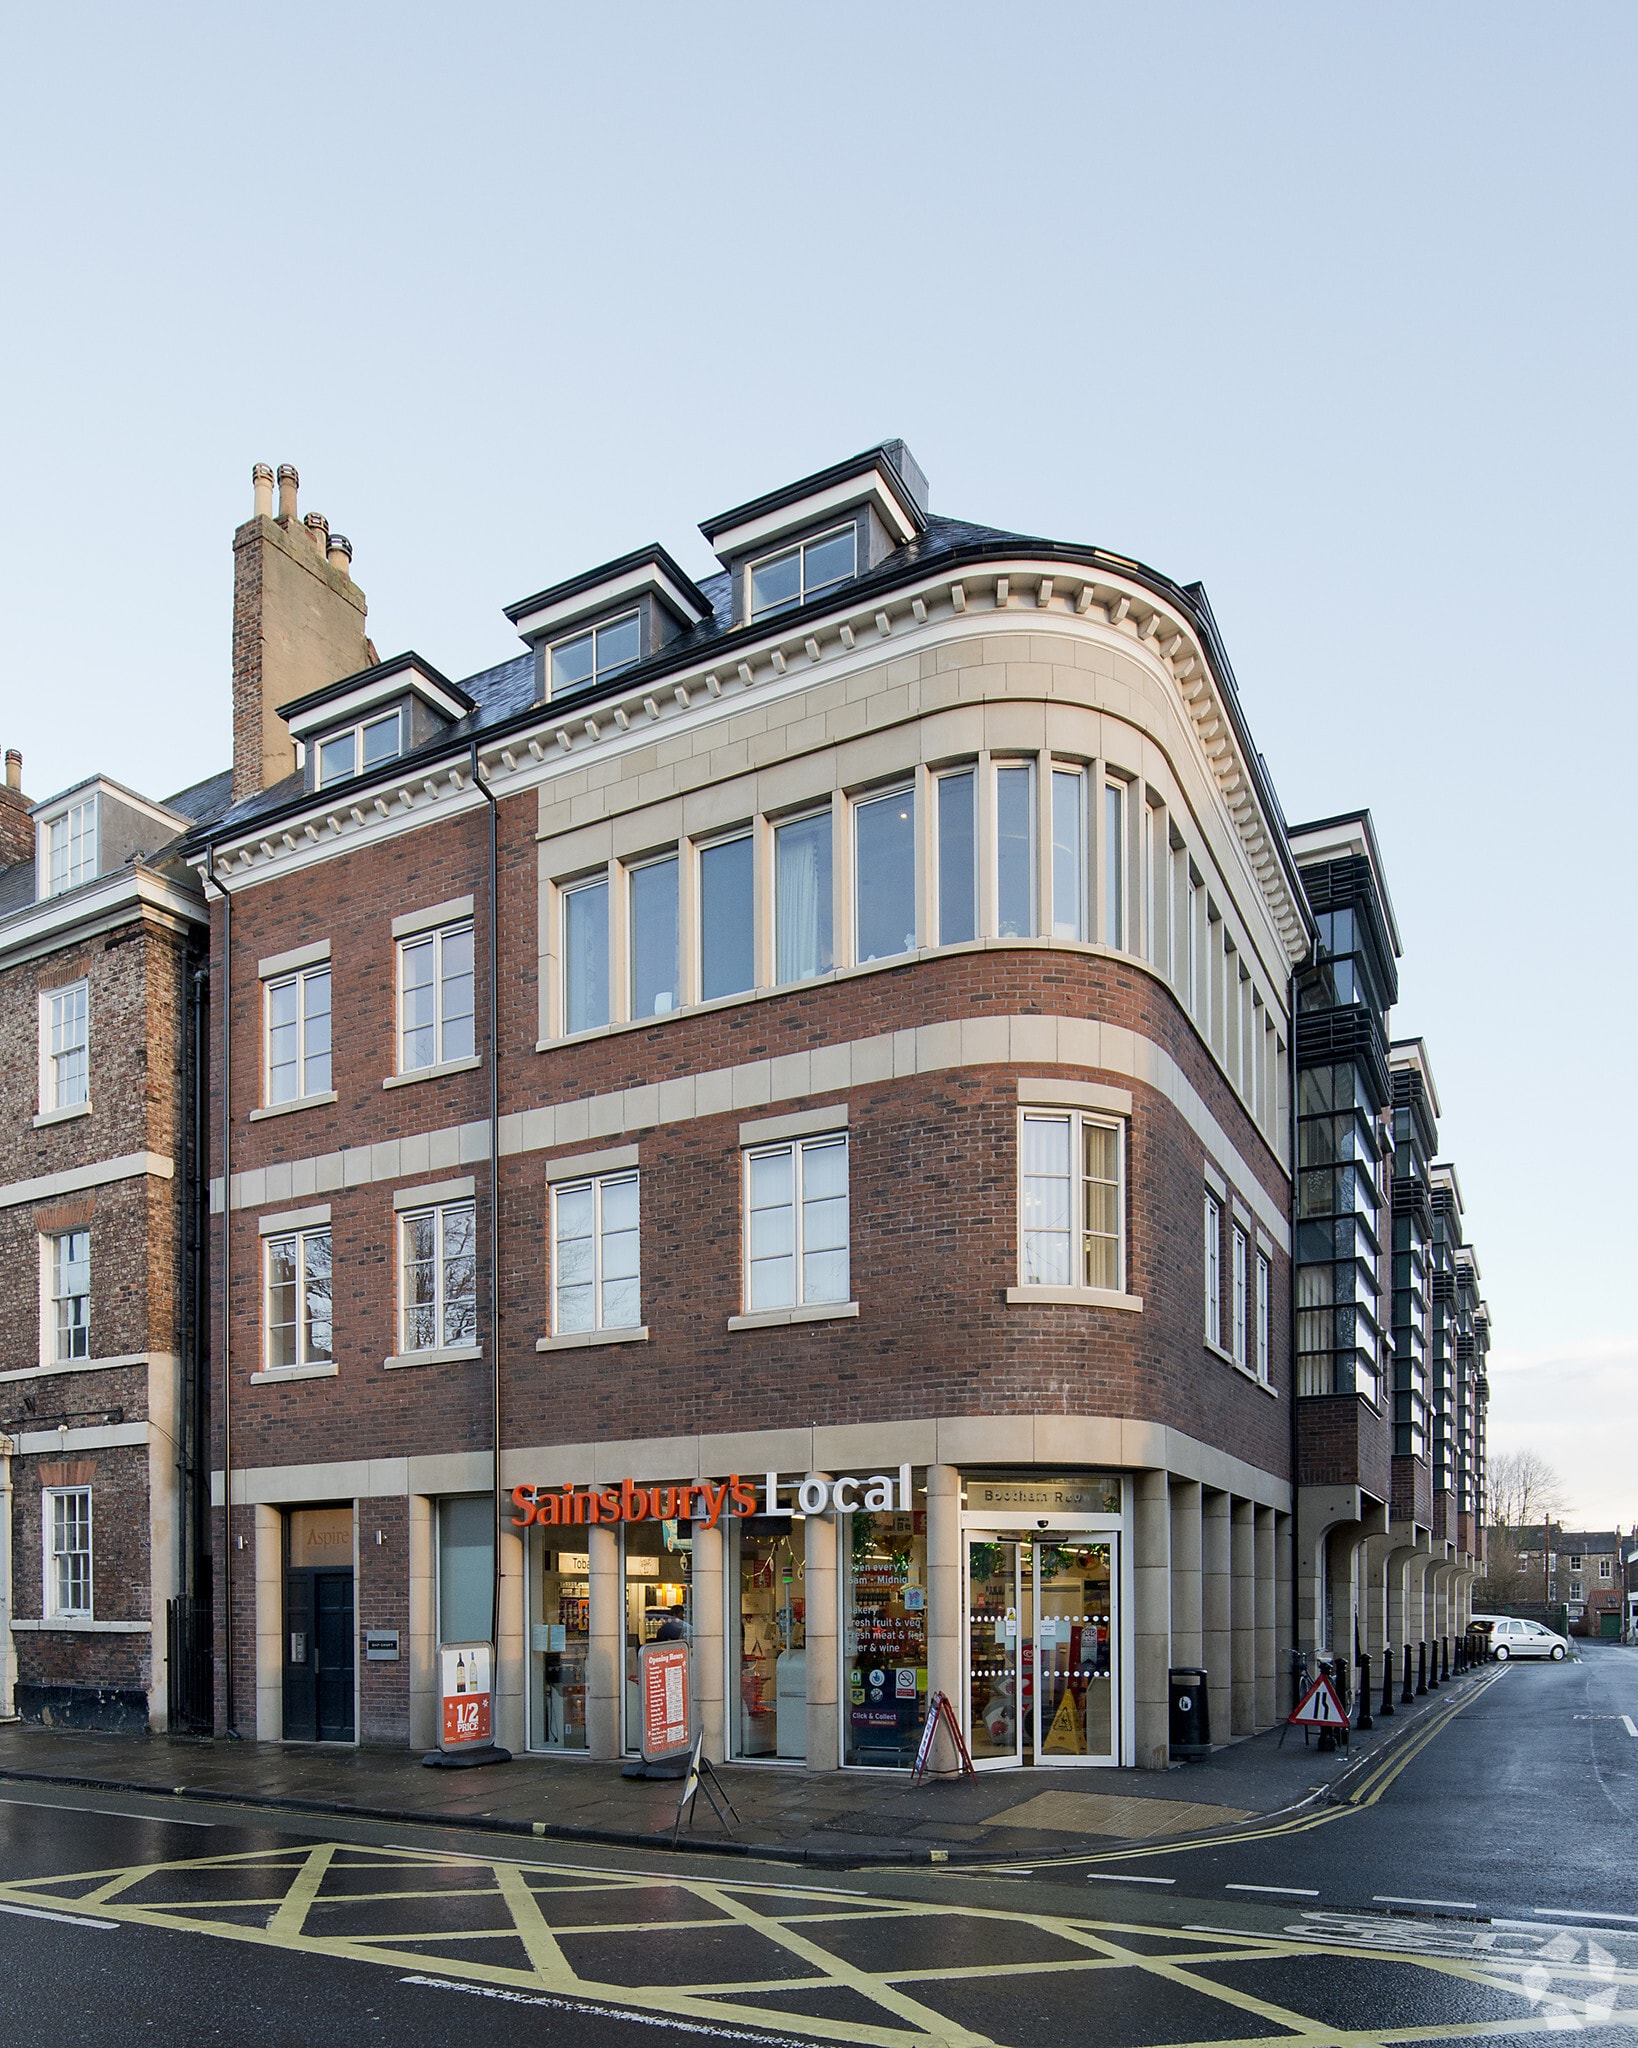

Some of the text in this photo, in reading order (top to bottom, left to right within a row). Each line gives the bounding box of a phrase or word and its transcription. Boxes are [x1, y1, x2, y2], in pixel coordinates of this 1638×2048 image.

[511, 1463, 912, 1530] Sainsbury's Local
[307, 1526, 349, 1549] Aspire
[572, 1557, 590, 1569] Toba
[873, 1564, 898, 1573] every
[847, 1605, 877, 1616] Bakery
[848, 1618, 921, 1629] resh fruit & veg
[848, 1631, 925, 1640] resh meat & fish
[869, 1644, 877, 1652] &
[879, 1644, 900, 1652] wine
[648, 1653, 684, 1665] Opening Hours
[456, 1702, 479, 1724] 1/2
[852, 1712, 867, 1720] Click
[456, 1721, 479, 1733] PRICE
